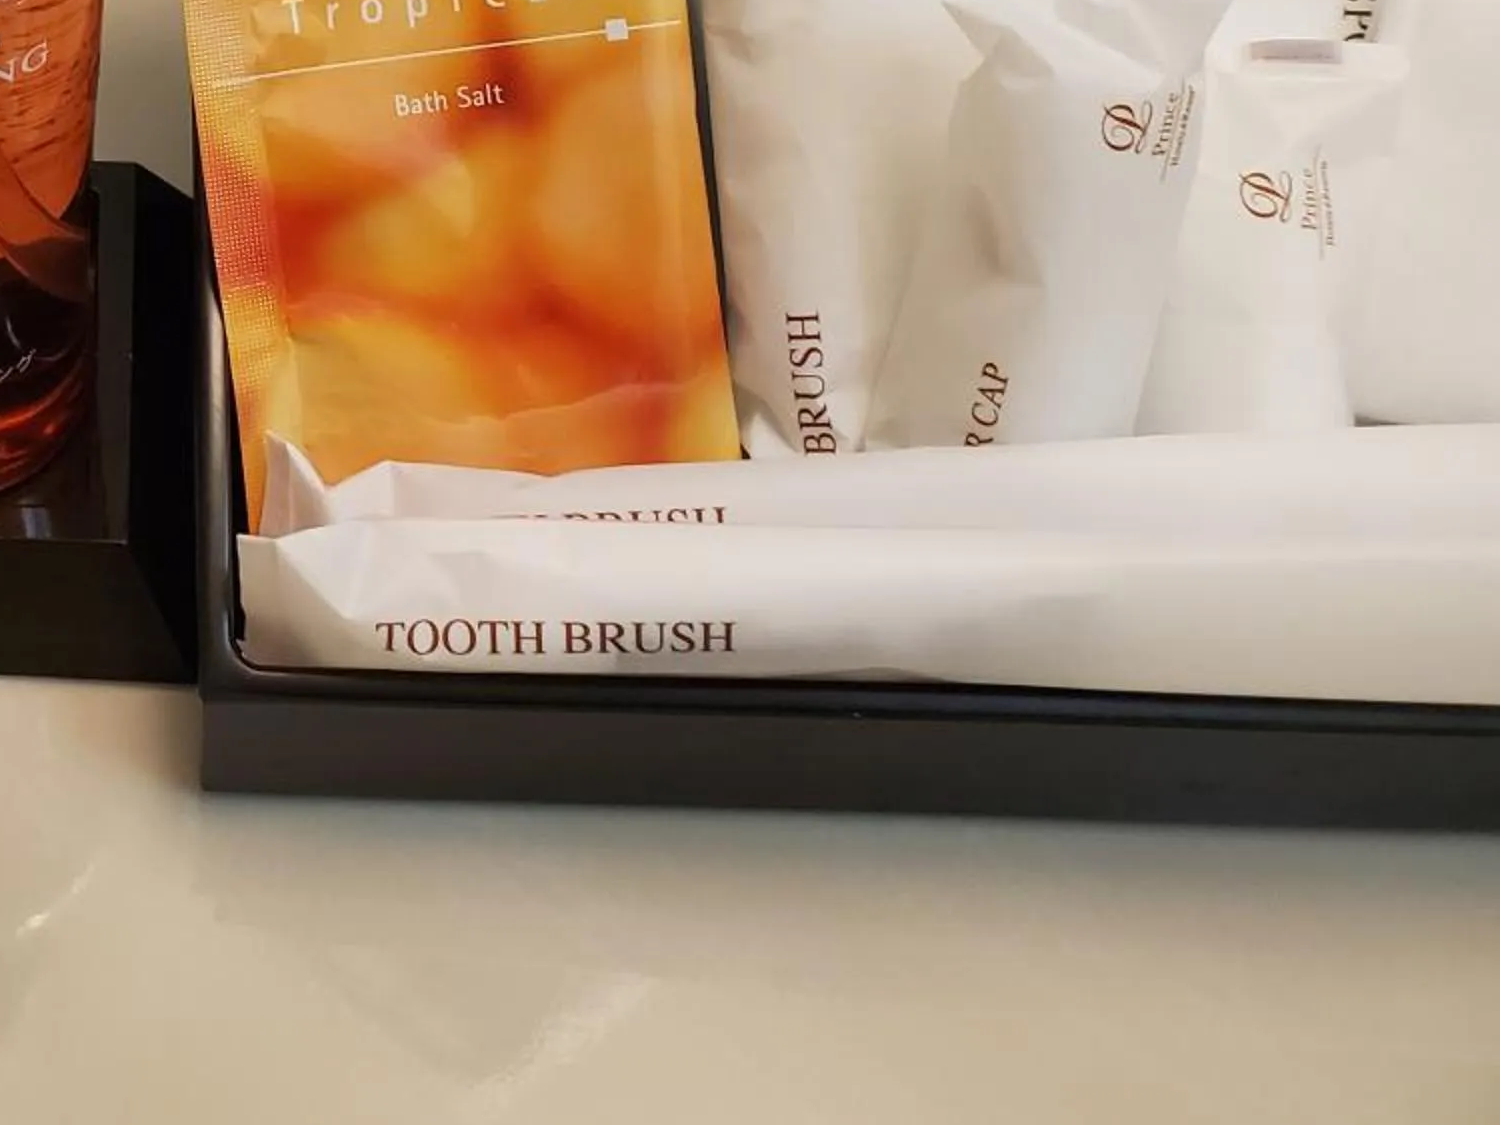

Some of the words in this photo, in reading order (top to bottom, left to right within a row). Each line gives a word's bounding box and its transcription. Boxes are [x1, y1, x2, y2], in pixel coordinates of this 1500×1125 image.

[394, 90, 450, 118] Bath
[456, 83, 505, 109] Salt
[1151, 92, 1180, 156] Prince
[785, 310, 838, 458] BRUSH
[970, 361, 1010, 429] CAP
[375, 618, 547, 656] TOOTH
[561, 621, 738, 656] BRUSH
